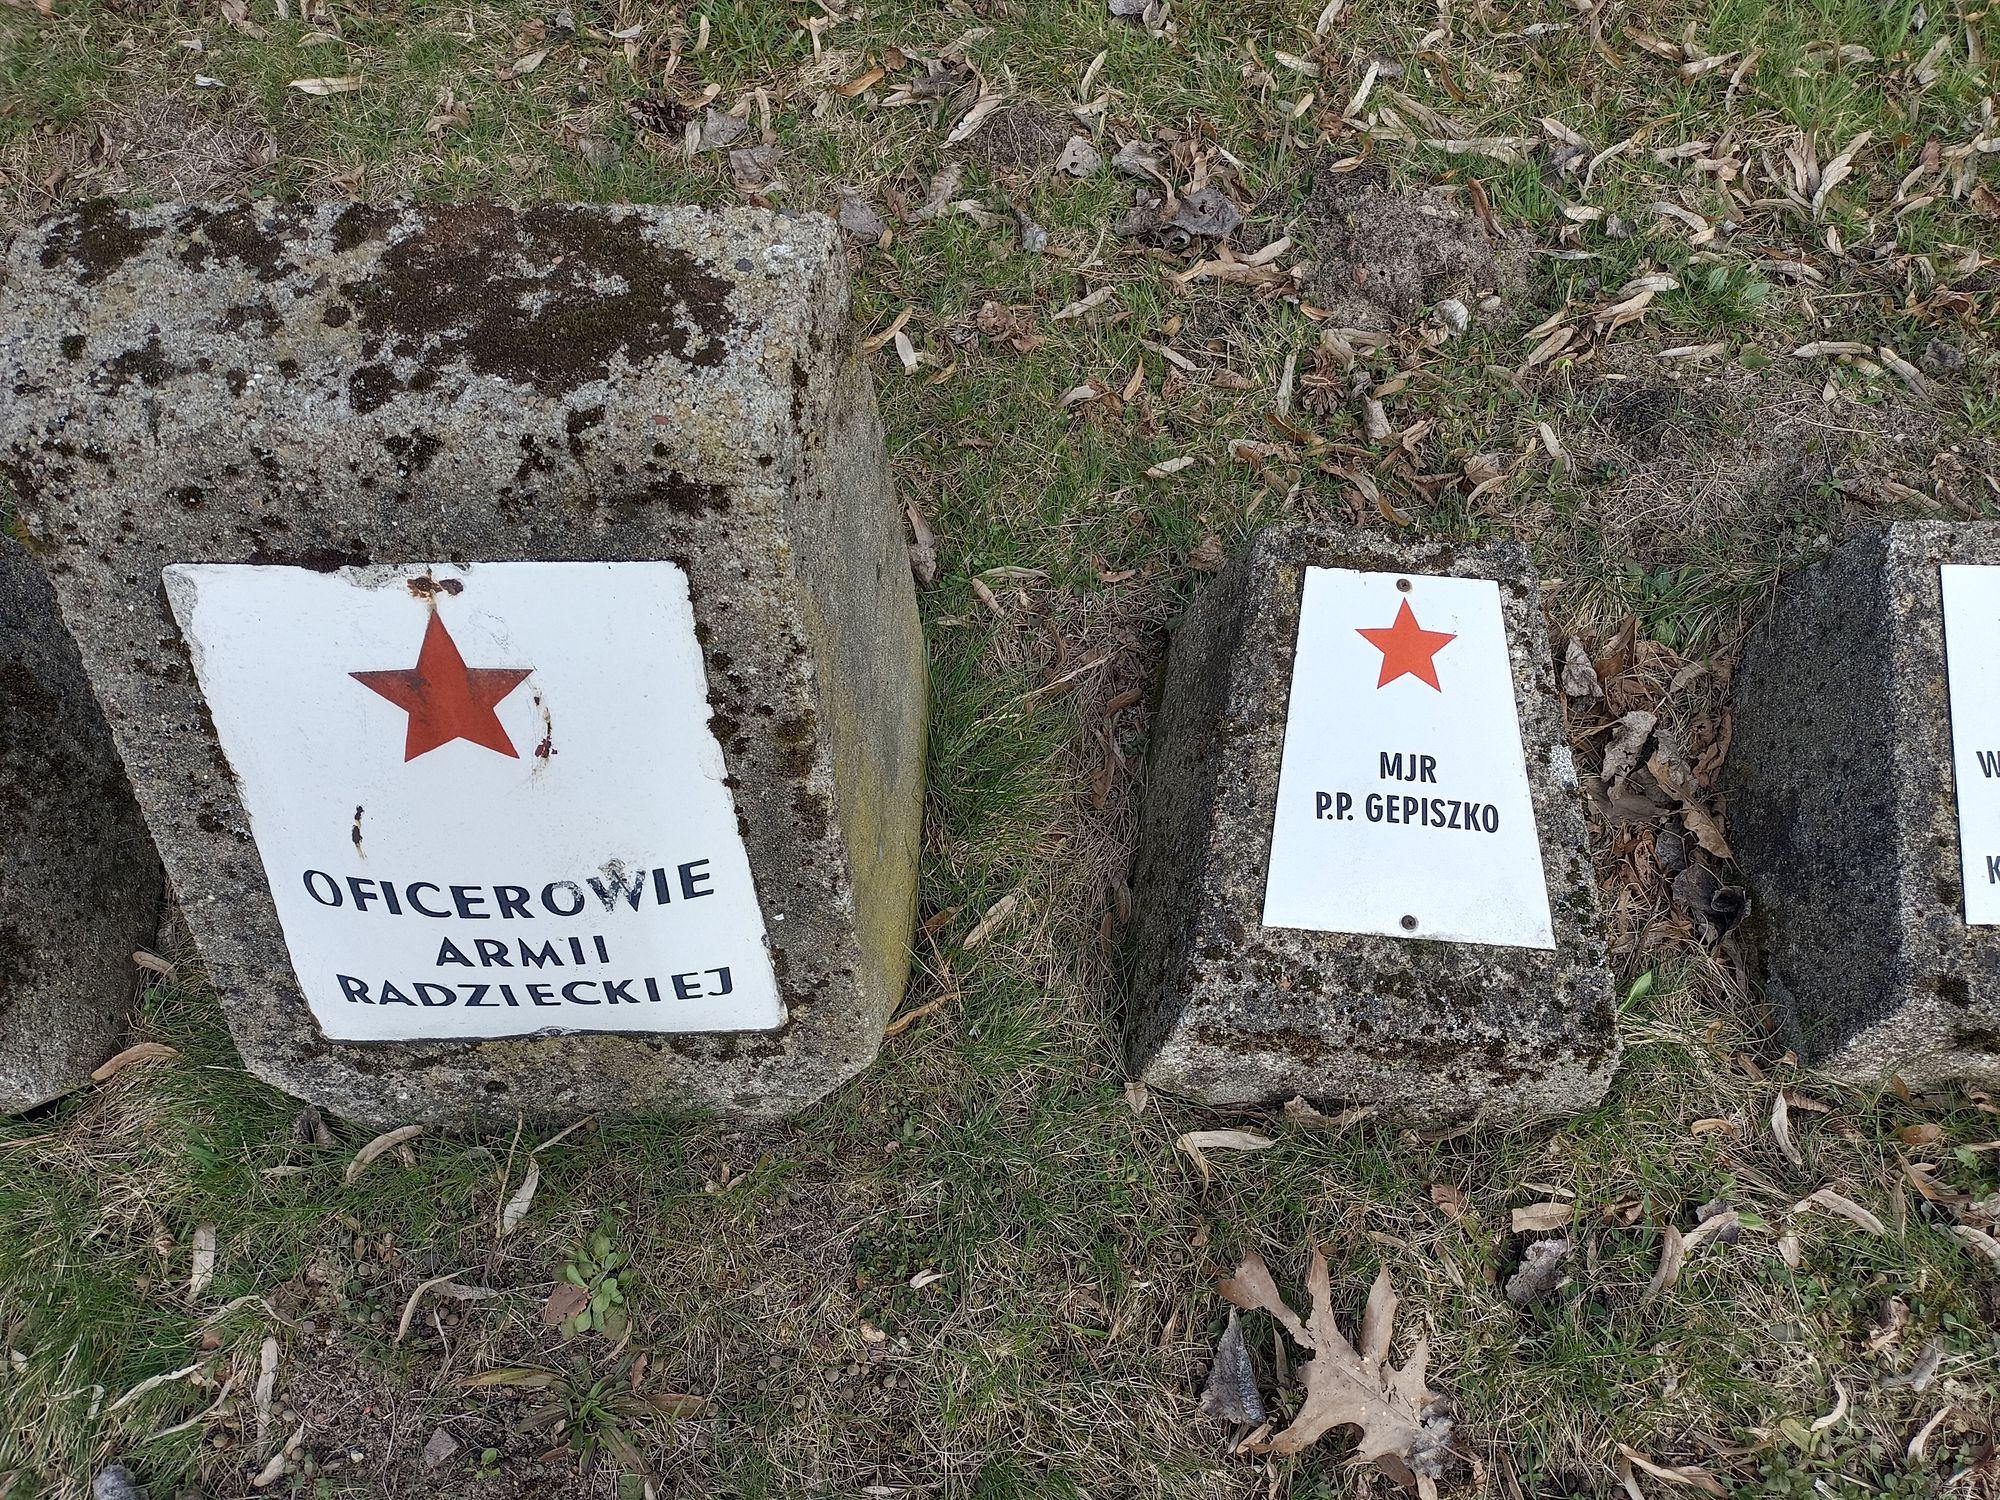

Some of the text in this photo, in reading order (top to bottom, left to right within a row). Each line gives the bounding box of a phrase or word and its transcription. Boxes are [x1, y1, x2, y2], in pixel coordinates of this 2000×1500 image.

[1380, 751, 1437, 783] MJR
[1315, 791, 1499, 833] P.P. GEPISZKO
[302, 858, 716, 919] OFICEROWIE
[435, 934, 612, 970] ARMII
[335, 966, 734, 1008] RADZIECKIEJ
